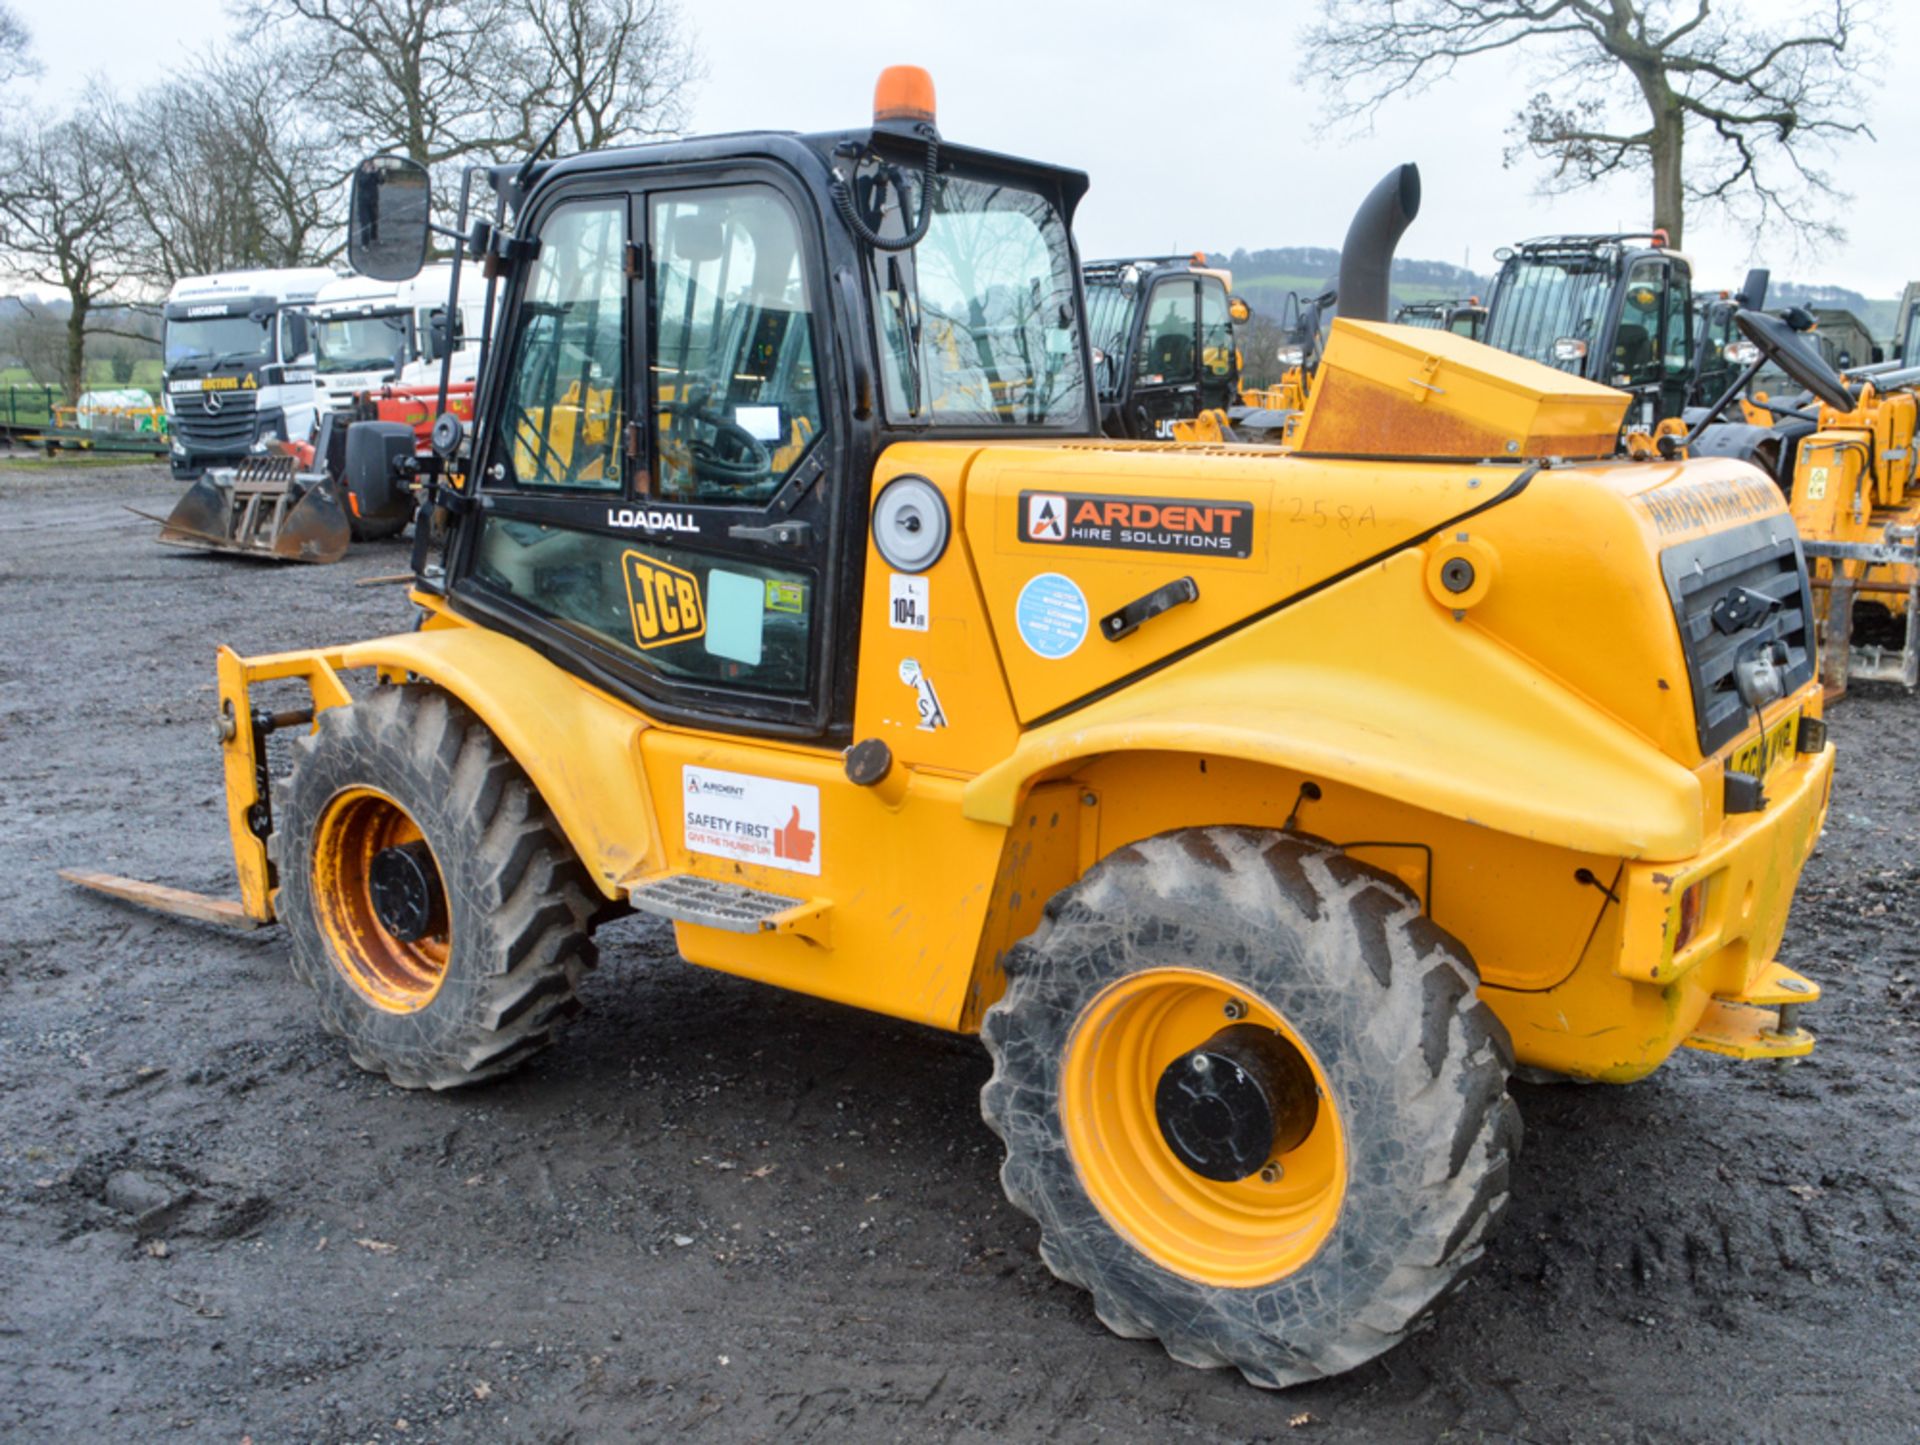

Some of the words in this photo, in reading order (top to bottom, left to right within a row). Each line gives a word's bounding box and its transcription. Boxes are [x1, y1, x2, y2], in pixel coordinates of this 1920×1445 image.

[1155, 419, 1177, 438] JC
[608, 508, 700, 532] LOADALL
[1073, 501, 1242, 534] ARDENT
[1071, 528, 1112, 541] HIRE
[1120, 530, 1232, 549] SOLUTIONS
[634, 562, 699, 639] JCB
[893, 597, 916, 625] 104
[703, 782, 744, 796] ARDENT
[688, 812, 732, 831] SAFETY
[734, 820, 769, 839] FIRST
[687, 831, 705, 843] GIVE
[706, 835, 721, 847] THE
[722, 839, 755, 853] THUMBS
